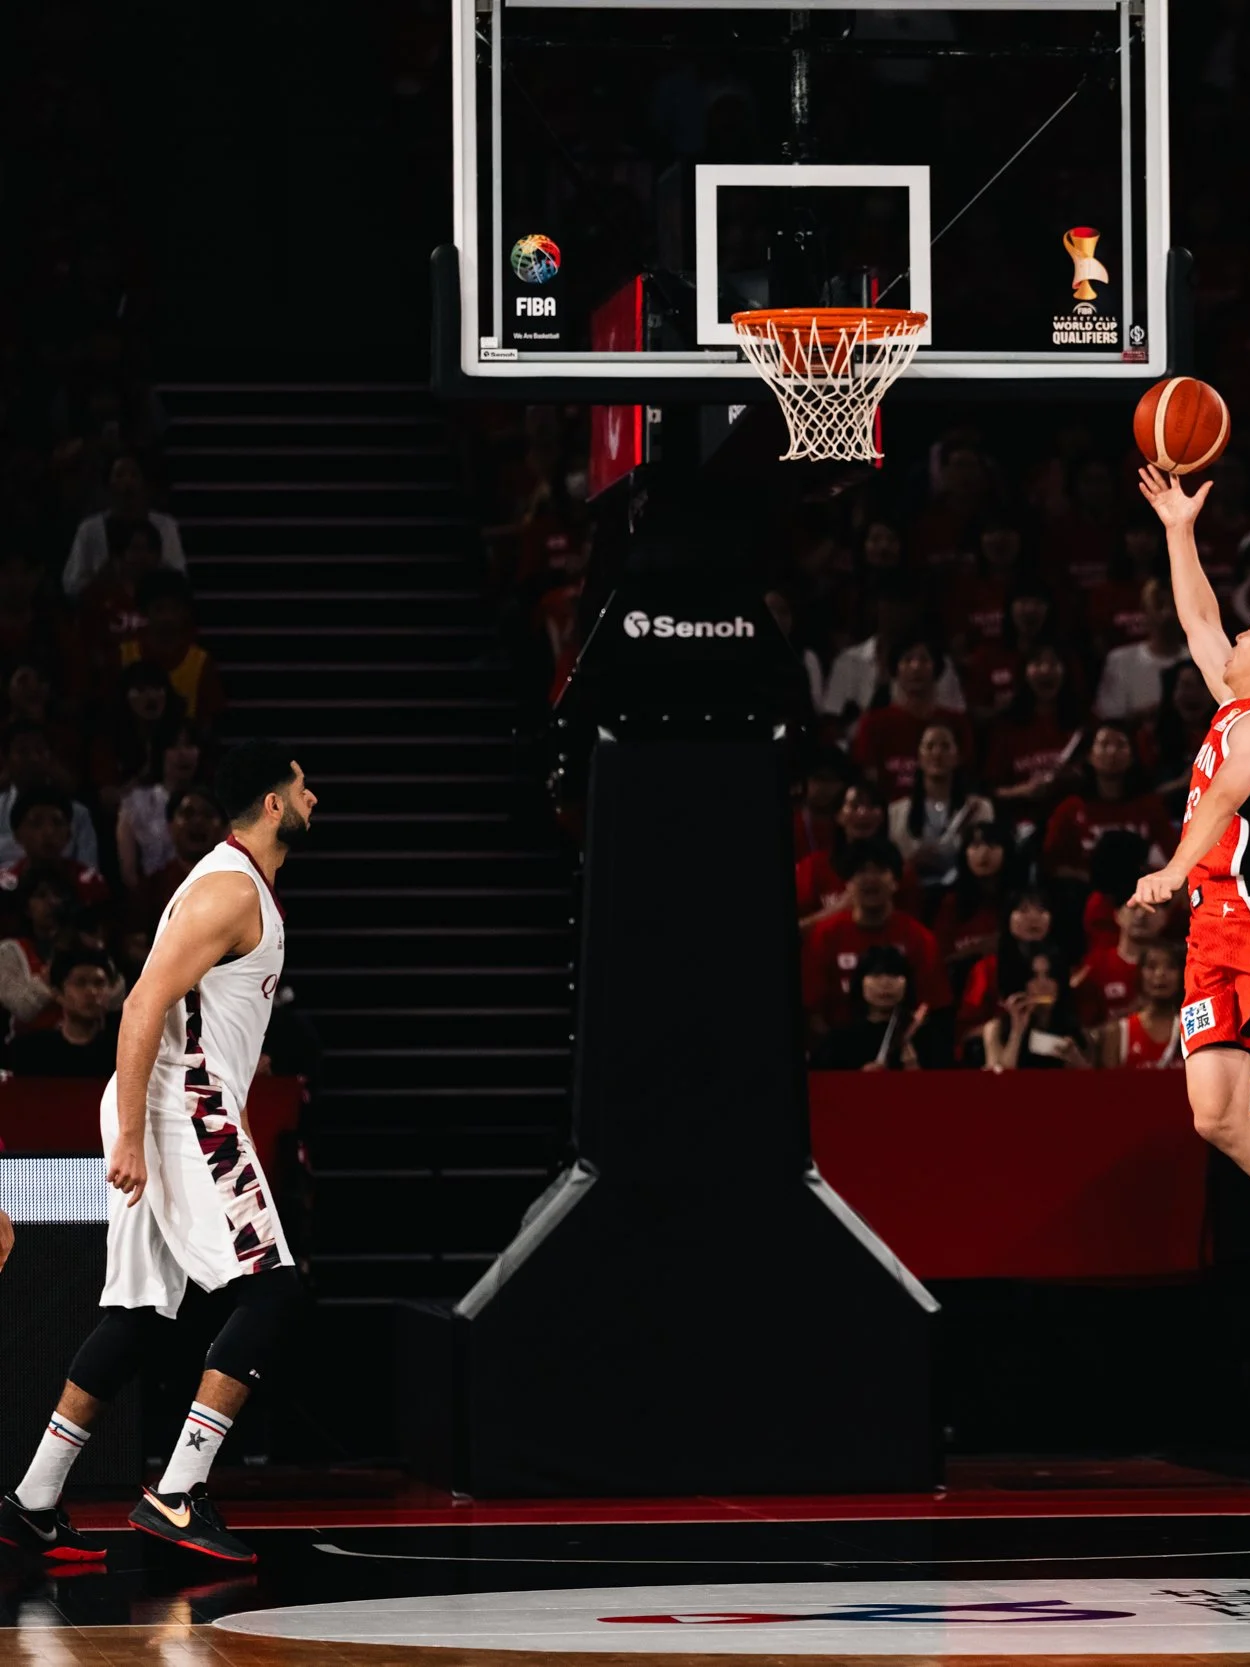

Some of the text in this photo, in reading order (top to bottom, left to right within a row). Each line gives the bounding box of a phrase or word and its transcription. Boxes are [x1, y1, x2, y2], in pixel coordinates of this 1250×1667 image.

[516, 297, 556, 317] FIBA
[1077, 307, 1093, 315] FIBA
[1053, 322, 1118, 331] WORLD CUP
[1052, 332, 1118, 345] QUALIFIERS
[653, 615, 755, 638] Senoh
